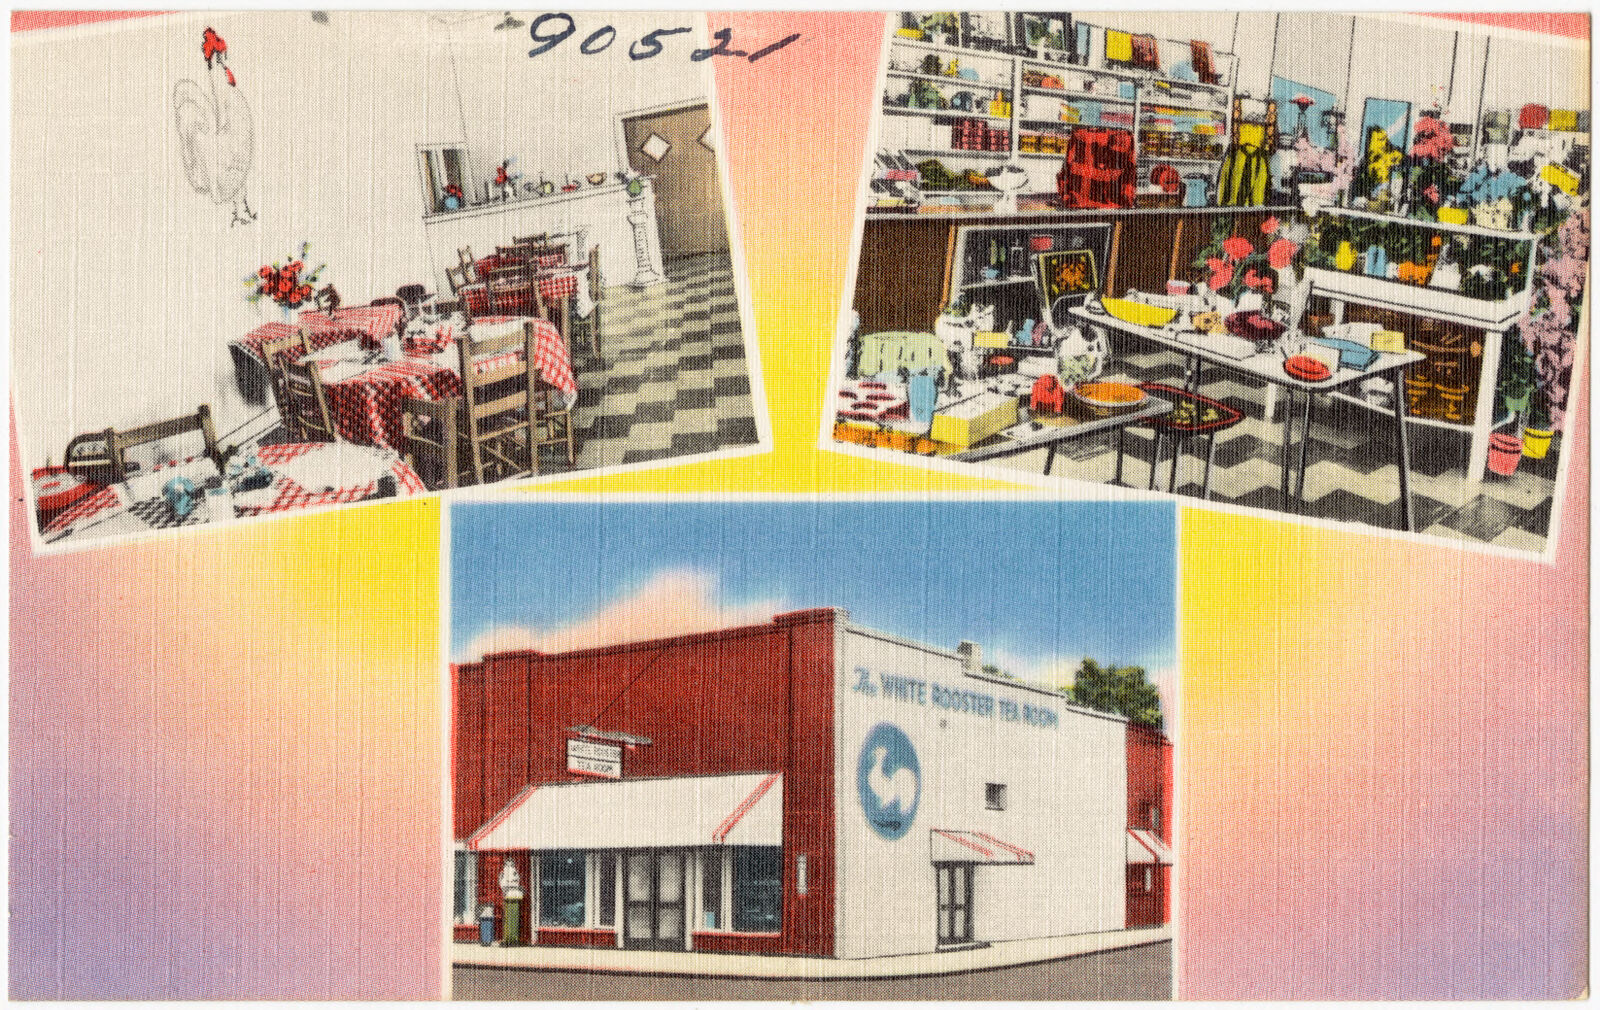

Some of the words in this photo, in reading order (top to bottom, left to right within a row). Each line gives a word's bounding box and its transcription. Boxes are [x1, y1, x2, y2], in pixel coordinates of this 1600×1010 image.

[880, 672, 927, 706] WHITE
[931, 682, 996, 718] ROOSTER
[999, 698, 1020, 722] TEA
[1022, 703, 1059, 728] ROOM
[577, 760, 591, 770] TEA
